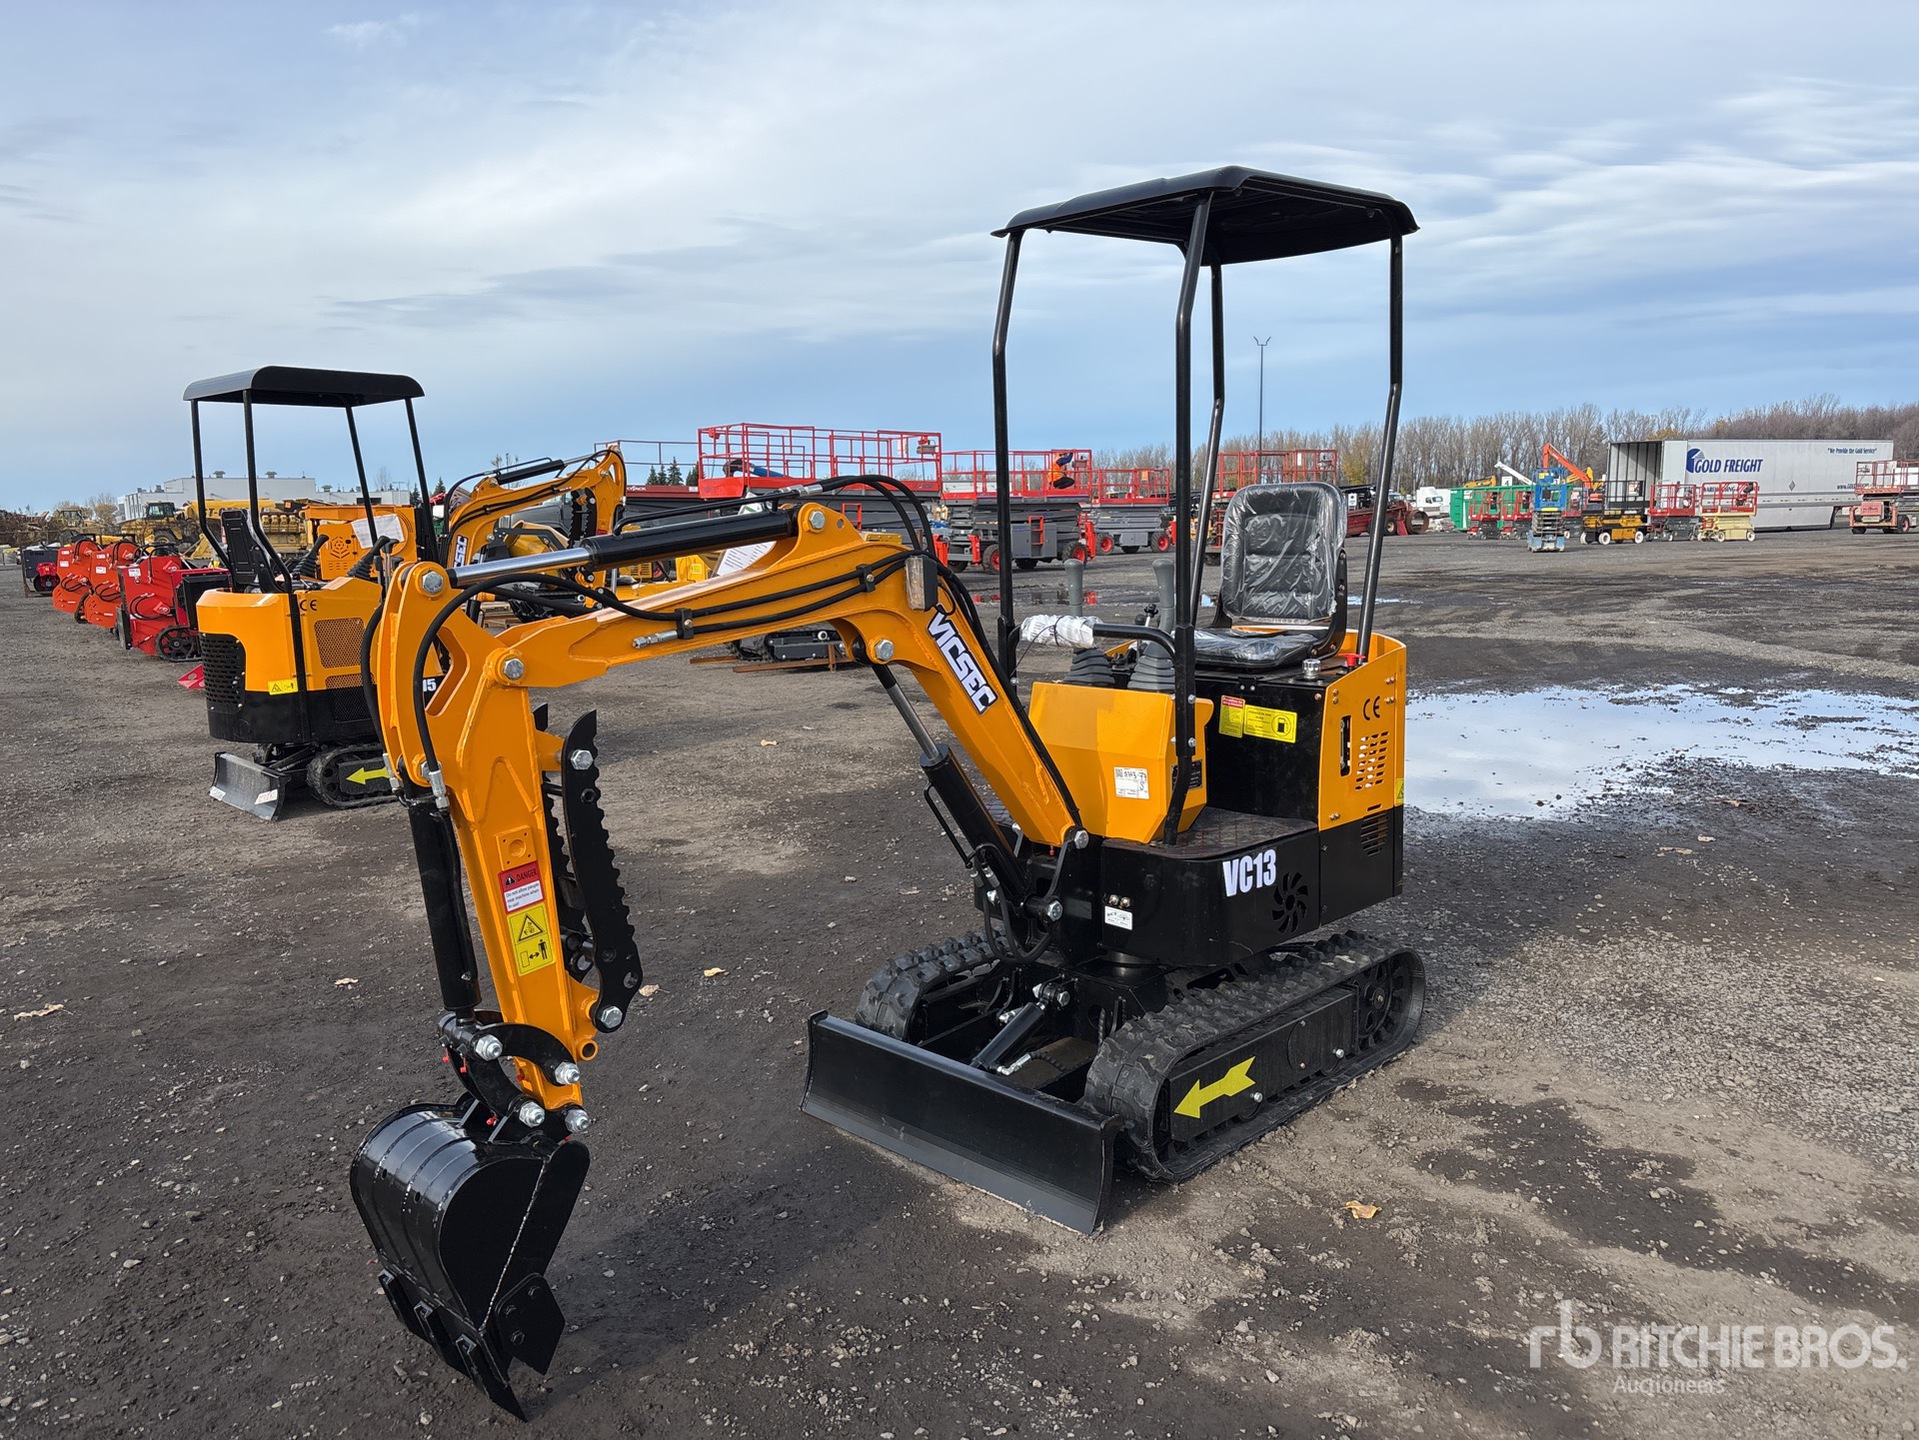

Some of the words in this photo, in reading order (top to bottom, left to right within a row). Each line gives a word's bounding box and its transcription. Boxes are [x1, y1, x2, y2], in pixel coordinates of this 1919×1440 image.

[1695, 459, 1721, 473] GOLD
[1723, 459, 1763, 472] FREIGHT
[422, 678, 436, 692] 15
[1363, 695, 1380, 721] CE
[516, 868, 538, 881] DANGER
[1222, 849, 1276, 897] VC13
